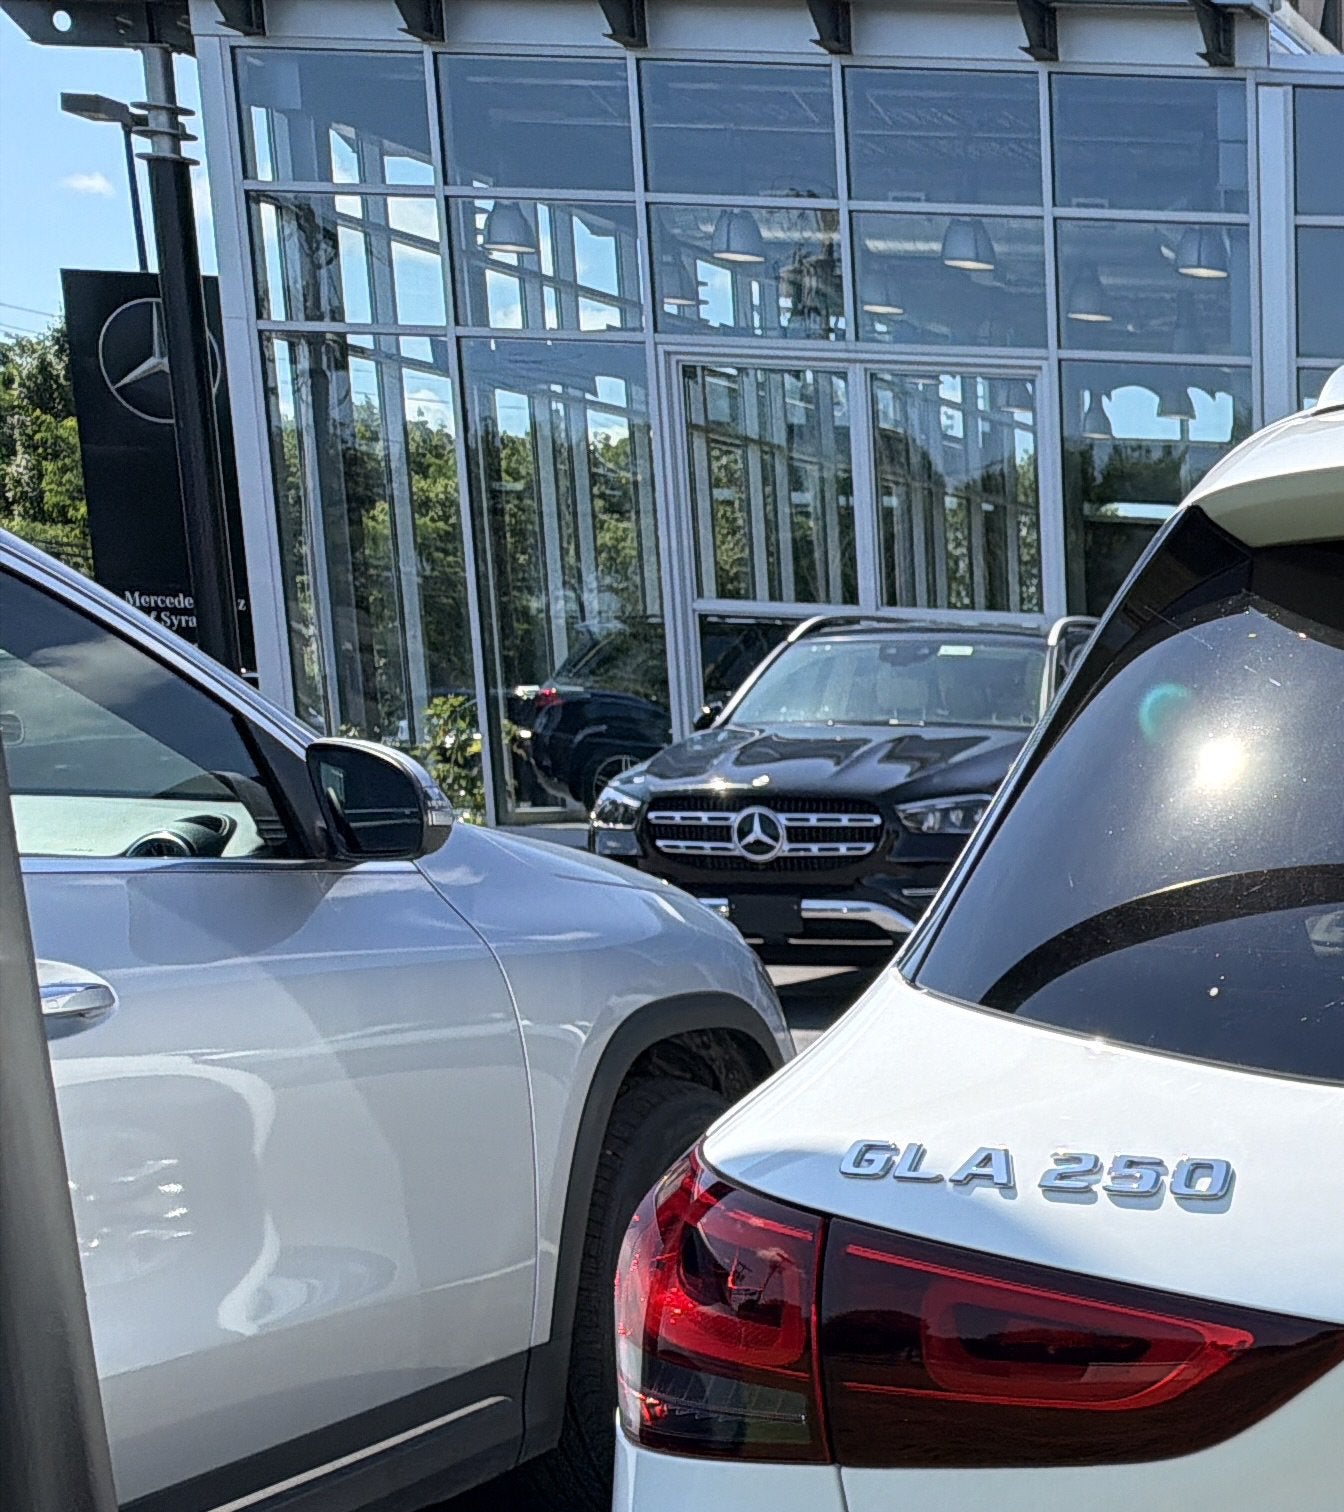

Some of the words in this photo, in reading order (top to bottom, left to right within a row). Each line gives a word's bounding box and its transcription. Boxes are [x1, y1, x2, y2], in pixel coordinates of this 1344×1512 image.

[160, 611, 198, 630] Syra
[839, 1139, 1015, 1190] GLA
[1038, 1152, 1232, 1201] 250
